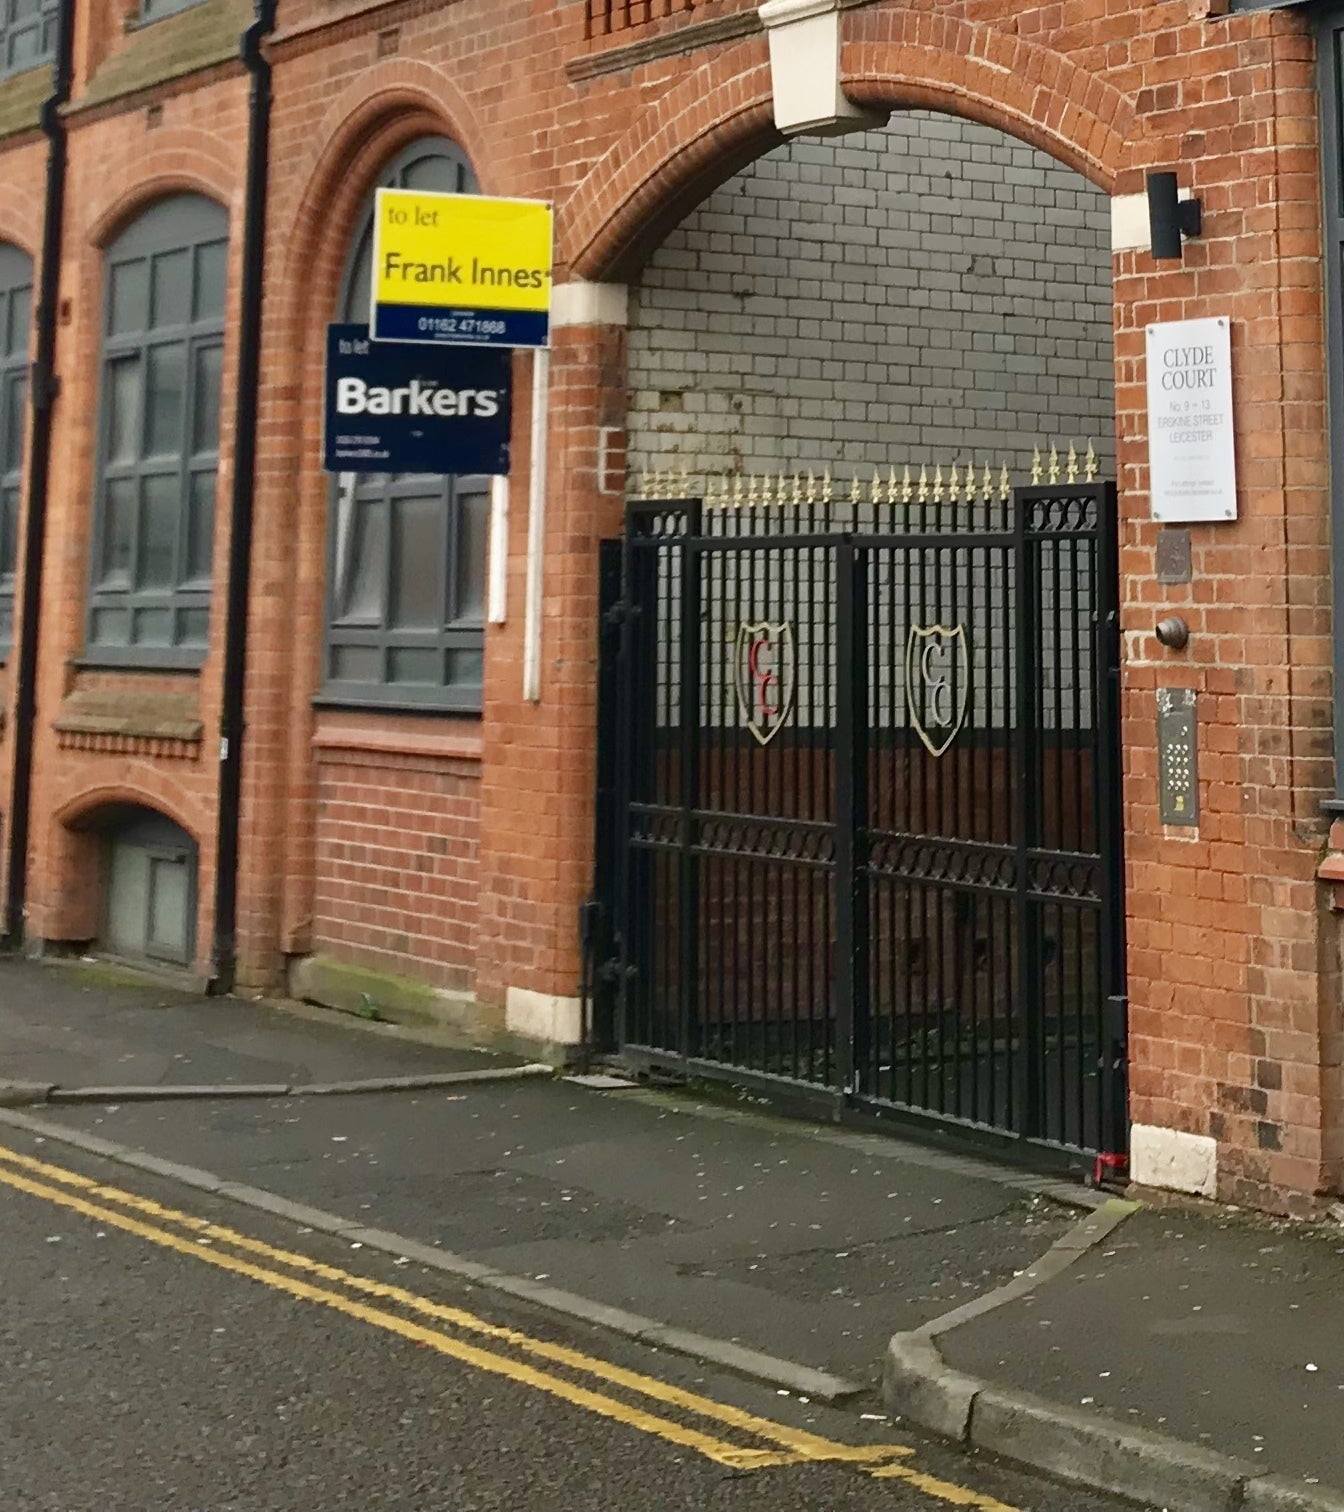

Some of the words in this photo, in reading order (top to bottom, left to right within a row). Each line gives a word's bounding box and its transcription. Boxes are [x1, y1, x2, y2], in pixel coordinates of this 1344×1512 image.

[388, 207, 407, 225] to
[415, 206, 439, 227] let
[385, 252, 462, 284] Frank
[472, 257, 542, 289] Innes
[1163, 345, 1214, 368] CLYDE
[1161, 368, 1217, 391] COURT
[336, 376, 499, 417] Barkers
[1183, 399, 1190, 411] 9
[1201, 399, 1211, 410] 13
[1157, 415, 1192, 428] ERSKINE
[1192, 413, 1224, 427] STREET
[1169, 430, 1213, 444] LEICESTER
